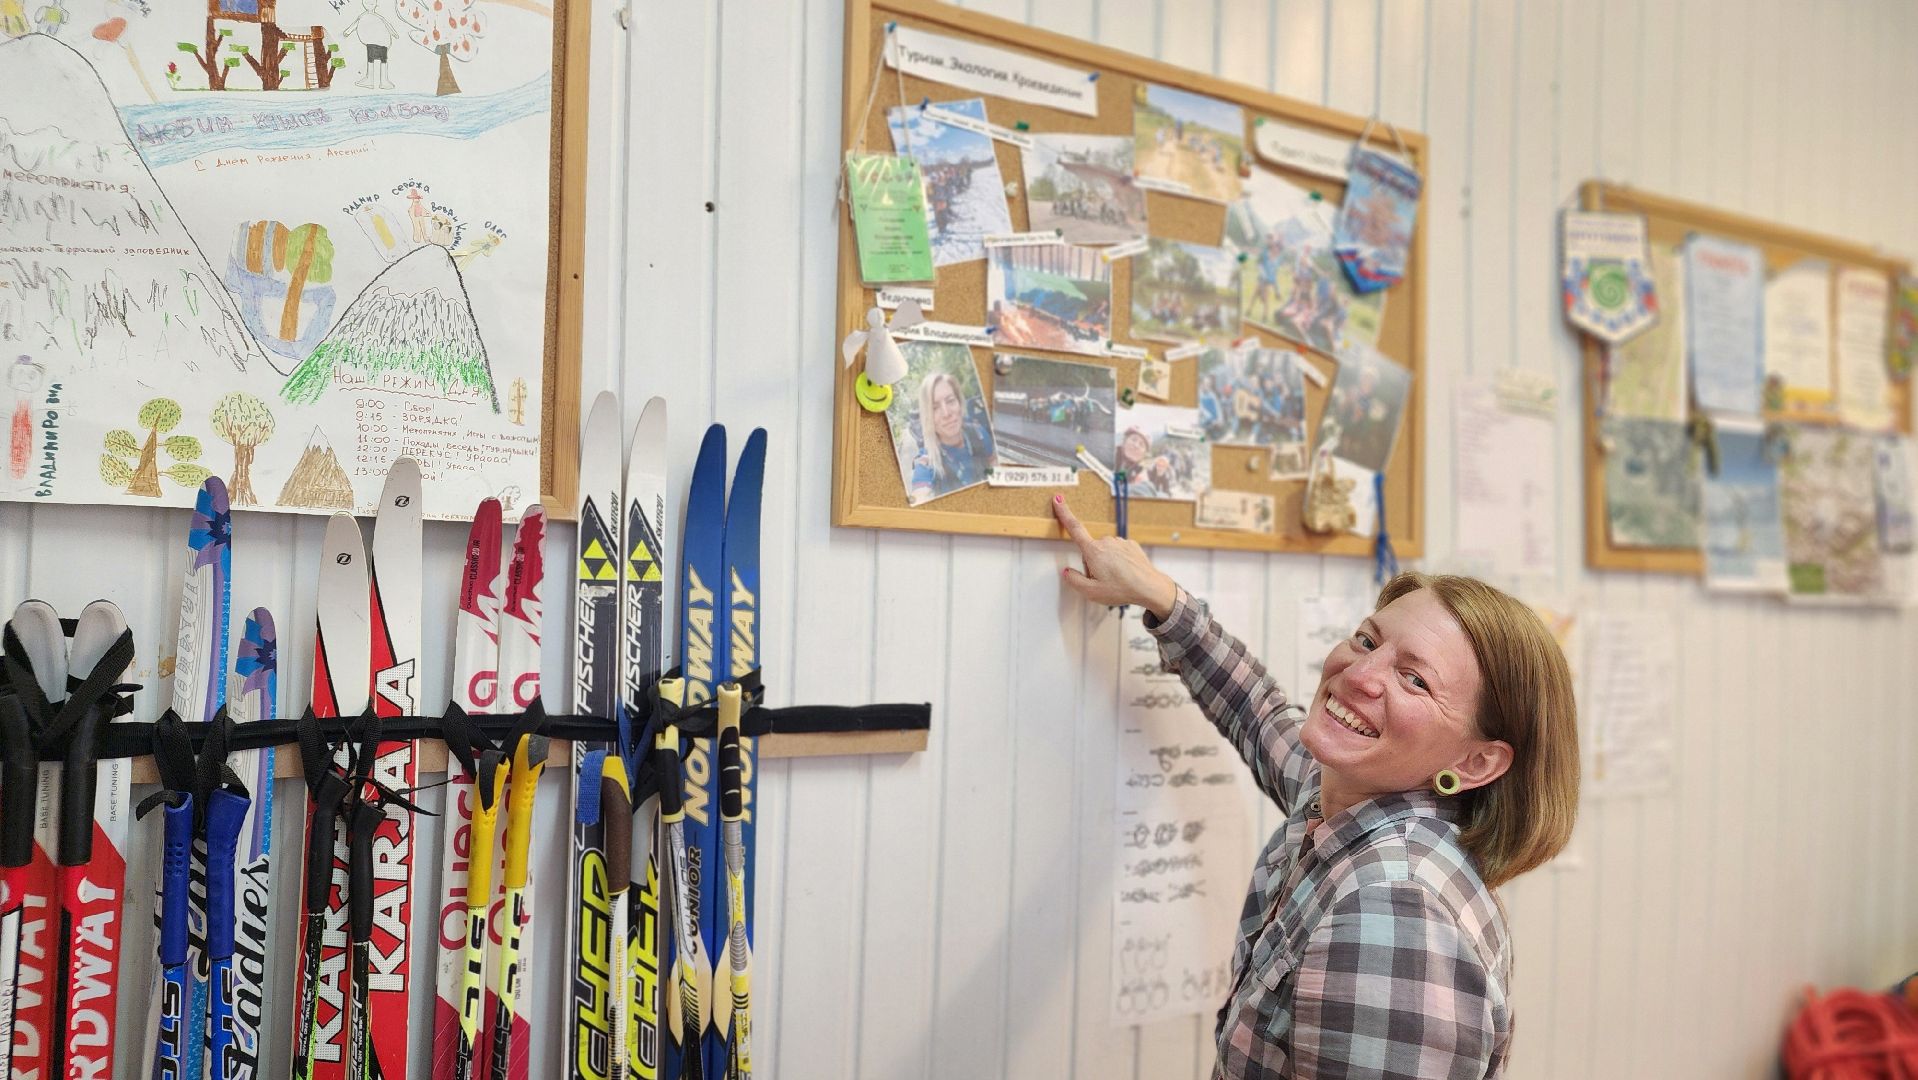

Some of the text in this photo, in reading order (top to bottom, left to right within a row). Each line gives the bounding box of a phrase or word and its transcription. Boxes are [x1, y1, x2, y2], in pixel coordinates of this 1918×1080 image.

[356, 399, 385, 409] 9:00
[356, 410, 382, 421] 9:15
[357, 423, 388, 433] 10:00
[358, 434, 391, 444] 11:00
[357, 445, 388, 453] 12:00
[356, 455, 386, 464] 12:15
[576, 582, 596, 714] FISCHER
[624, 584, 642, 712] FISCHER
[684, 563, 714, 826] NODWAY
[110, 763, 120, 822] BASE TUNING
[39, 807, 49, 829] BASE
[367, 657, 416, 992] KARJAA
